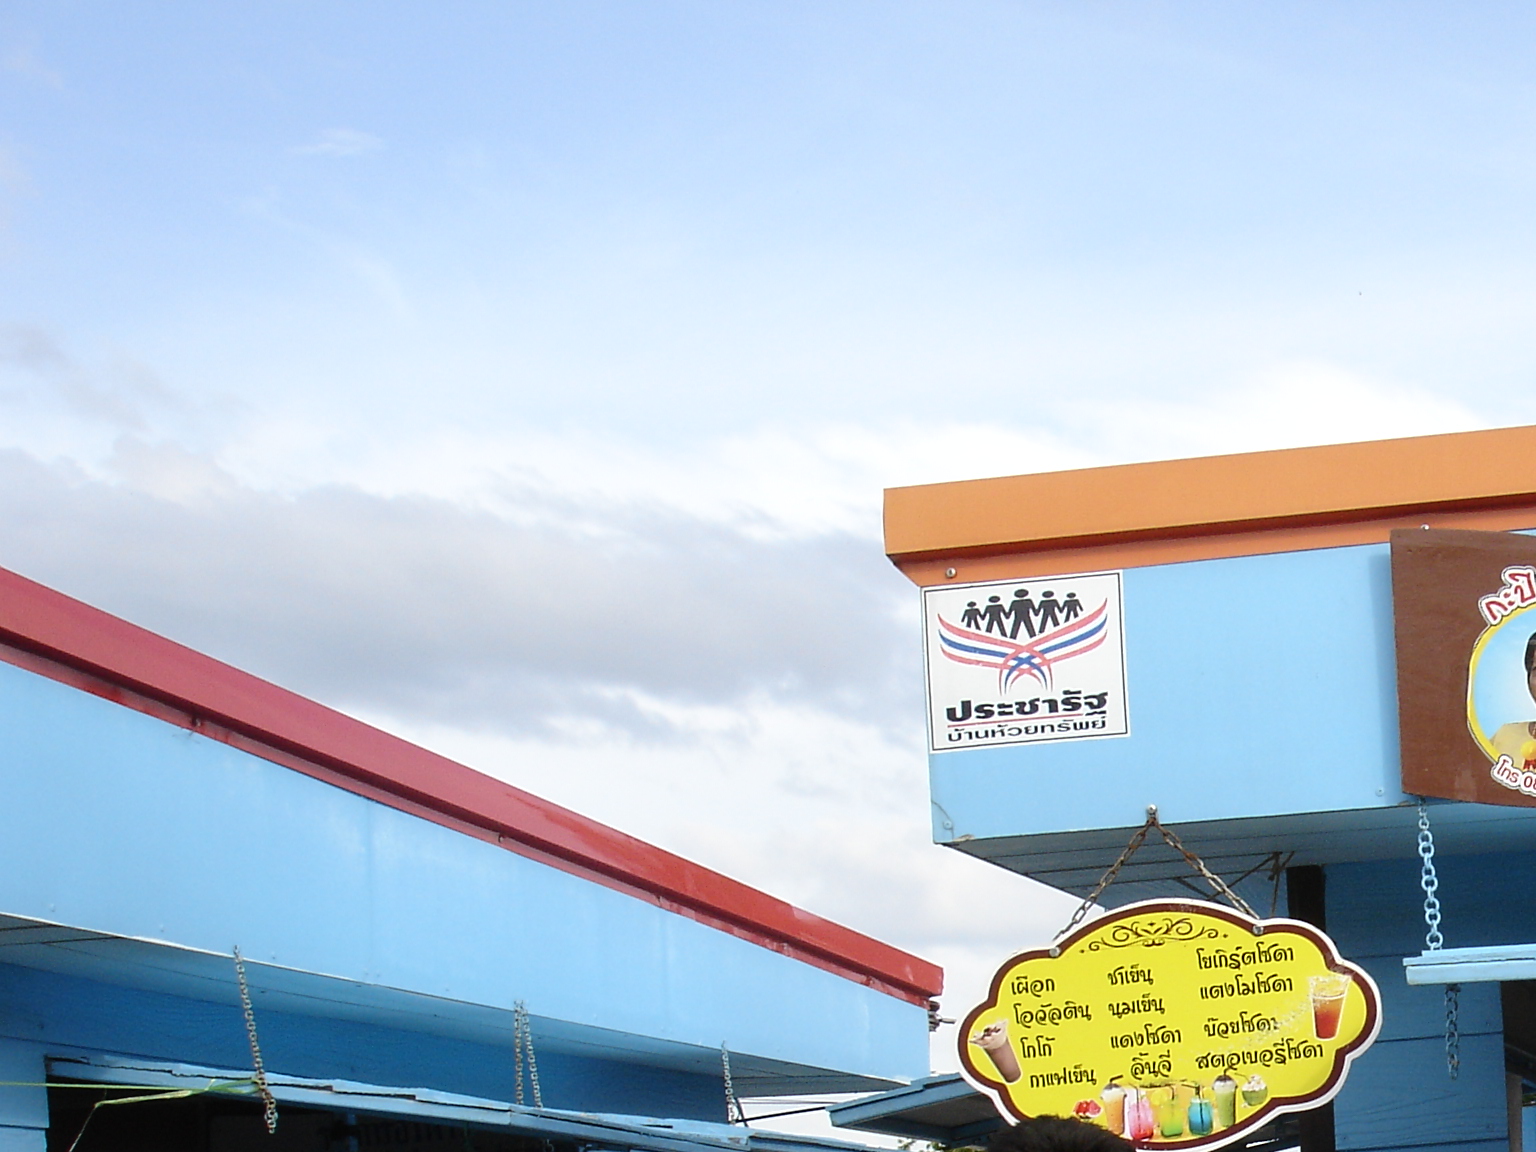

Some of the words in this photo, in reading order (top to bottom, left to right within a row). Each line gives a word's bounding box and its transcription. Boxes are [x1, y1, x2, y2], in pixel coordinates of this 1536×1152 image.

[946, 690, 1108, 722] ประชารัฐ
[947, 716, 1107, 742] บ้านห้วยทรัพย์
[1496, 760, 1519, 783] โทร
[1196, 942, 1294, 970] โยเกิร์ตโซดา
[1011, 976, 1056, 998] เผือก
[1108, 964, 1154, 986] ชาเย็น
[1013, 1001, 1092, 1029] โอวัลติน
[1109, 993, 1166, 1019] นมเย็น
[1020, 1035, 1056, 1059] โกโก้
[1110, 1023, 1182, 1050] แดงโซดา
[1029, 1063, 1098, 1089] กาแฟเย็น
[1130, 1050, 1172, 1081] ลิ้นจี่
